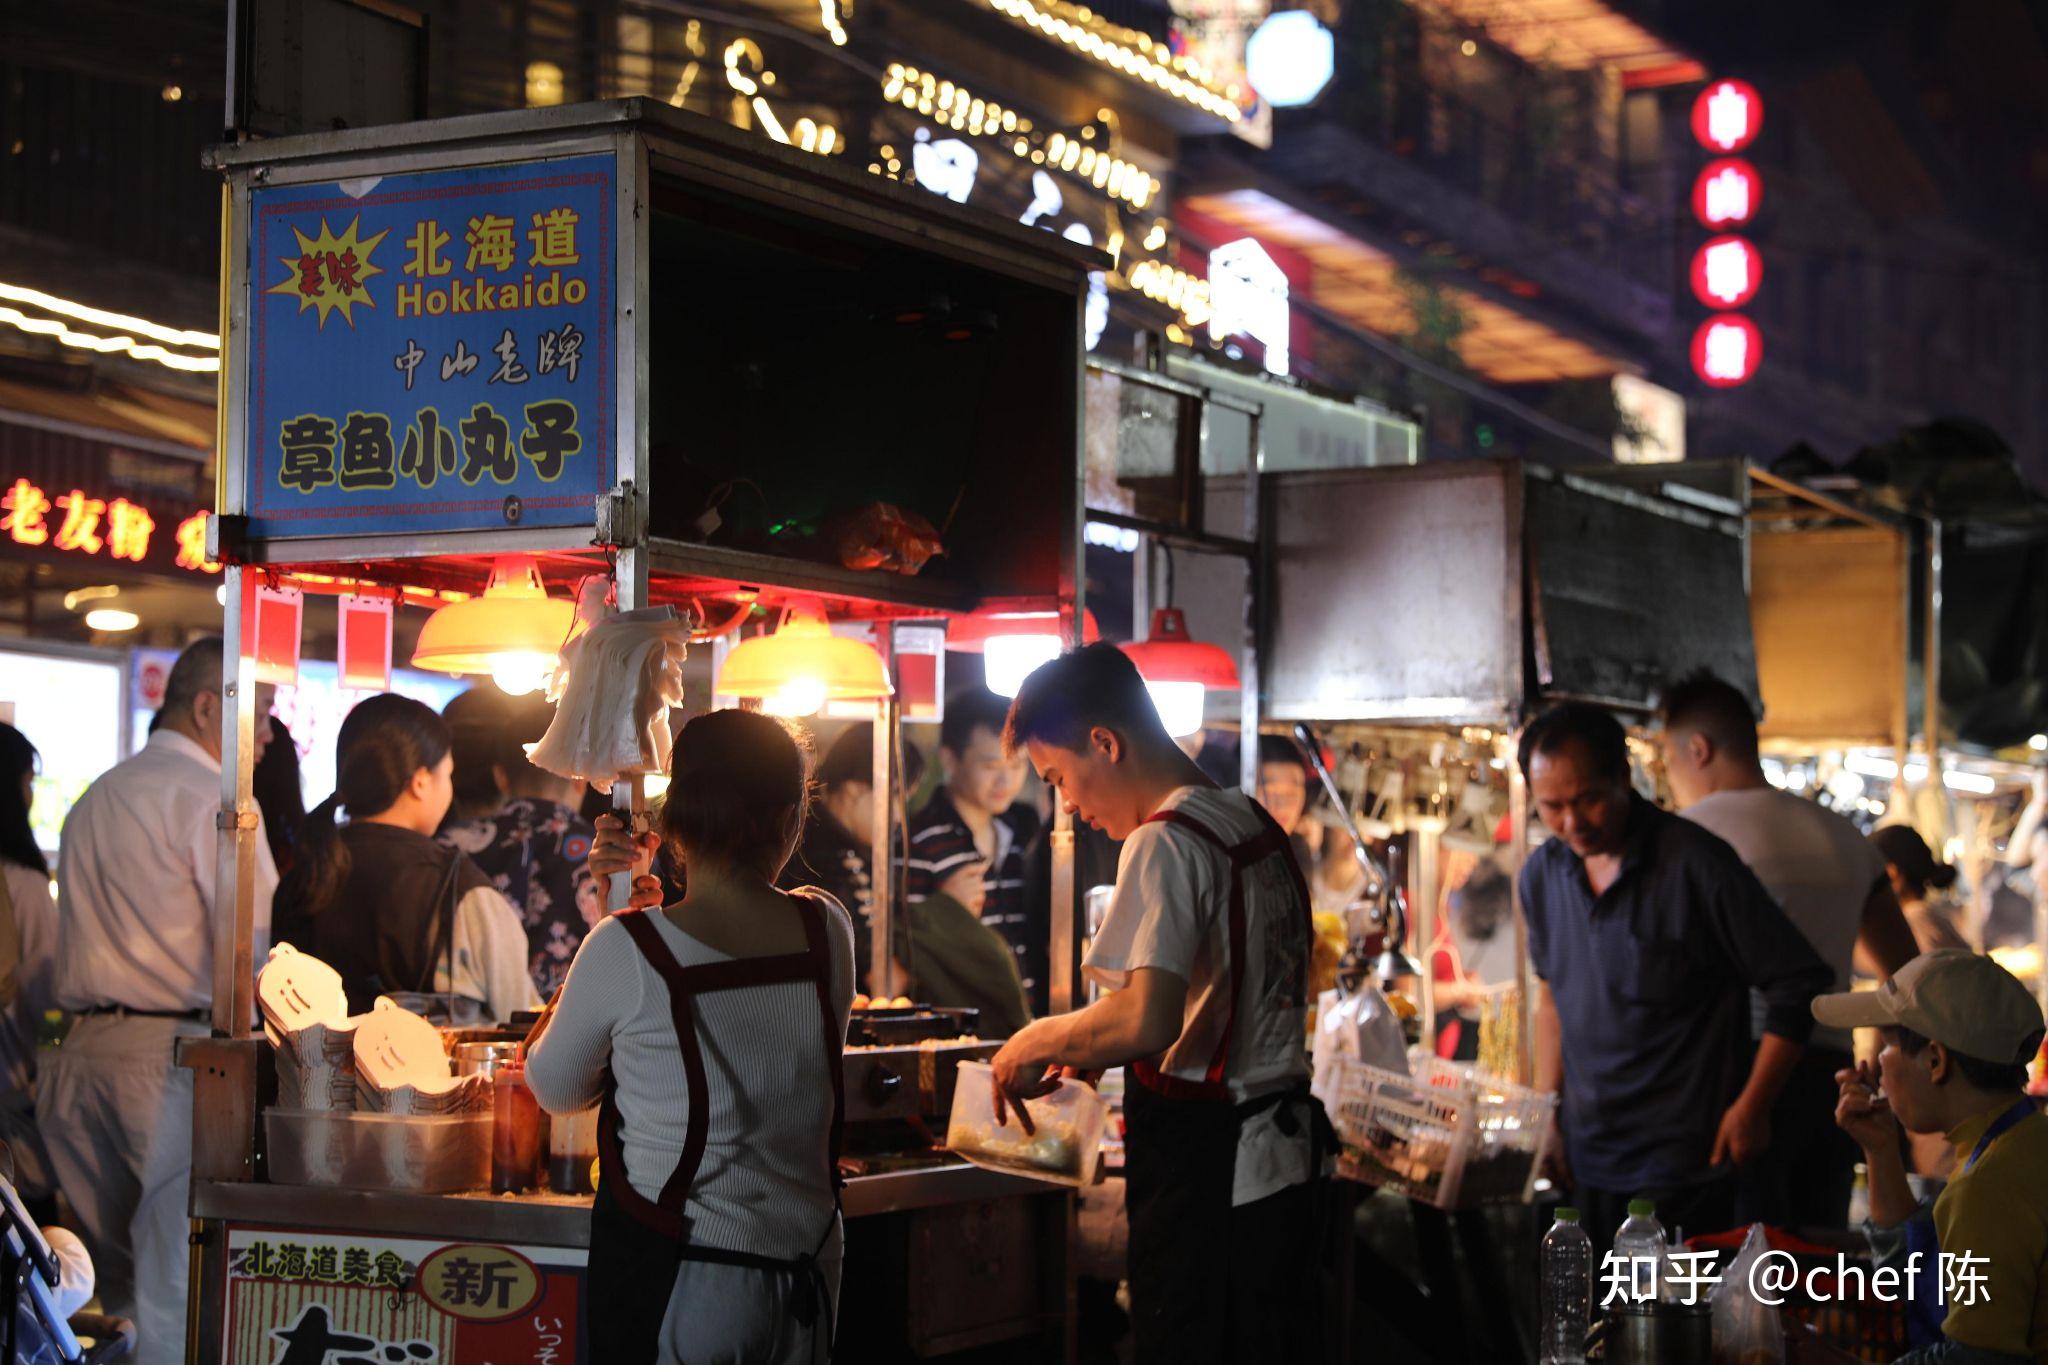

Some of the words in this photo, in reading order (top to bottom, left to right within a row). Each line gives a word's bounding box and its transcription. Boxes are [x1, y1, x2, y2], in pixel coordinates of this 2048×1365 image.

[403, 208, 581, 278] 北海道
[298, 247, 362, 299] 美味
[396, 271, 588, 318] Hokkaido
[394, 323, 585, 389] 中山老牌
[278, 399, 582, 494] 章鱼小丸子
[246, 1240, 403, 1288] 北海道美食
[440, 1257, 519, 1310] 新
